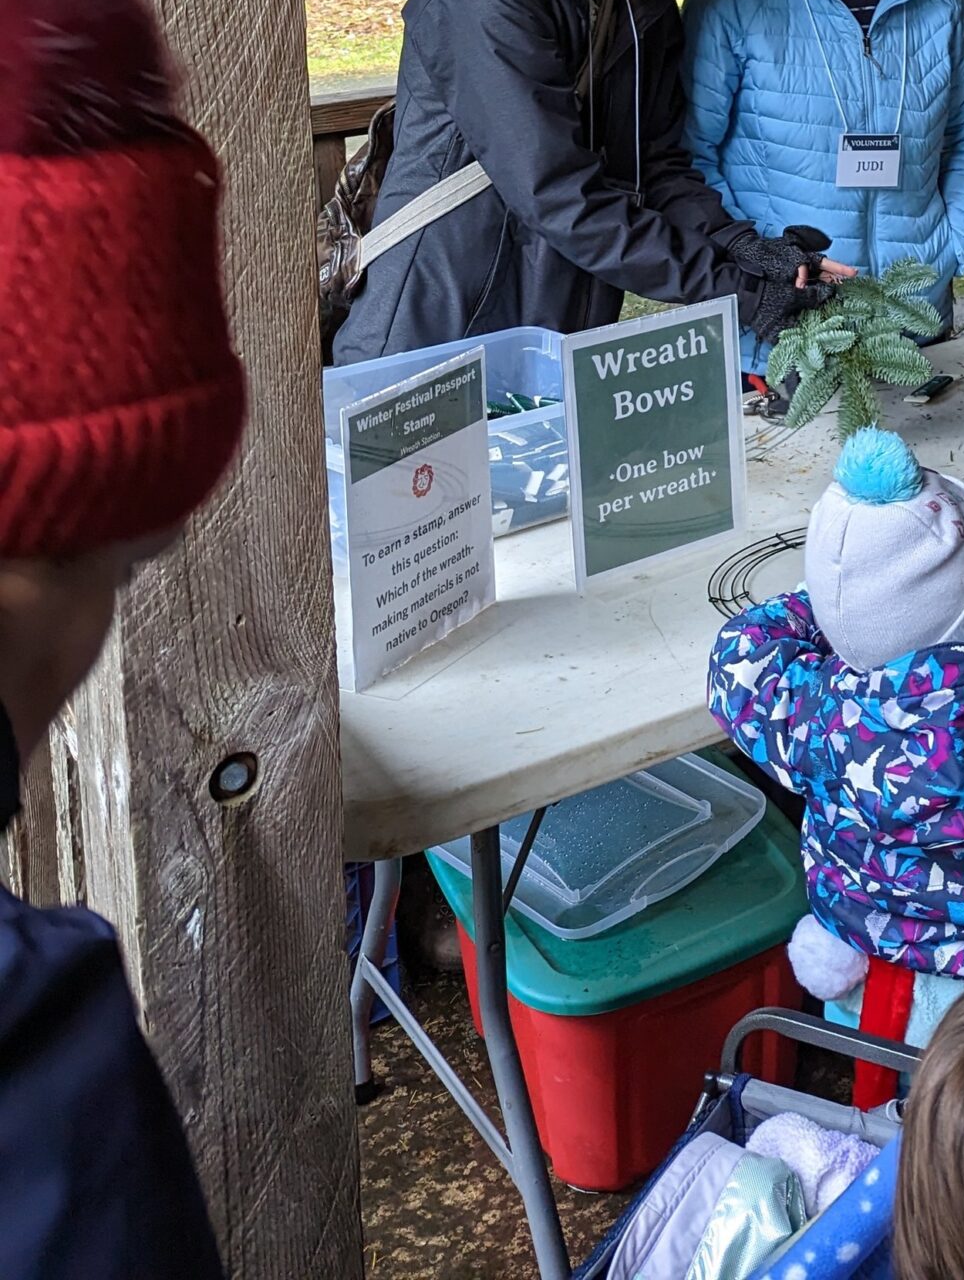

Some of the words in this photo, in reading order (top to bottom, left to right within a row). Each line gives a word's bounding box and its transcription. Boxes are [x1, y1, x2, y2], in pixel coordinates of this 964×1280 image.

[856, 161, 884, 173] JUDI
[591, 328, 708, 380] Wreath
[356, 408, 394, 433] Winter
[395, 387, 433, 416] Festival
[434, 368, 476, 397] Passport
[403, 412, 436, 435] Stamp
[613, 381, 694, 420] Bows
[400, 441, 421, 457] Wreath
[663, 445, 705, 469] bow
[362, 552, 376, 567] To
[378, 539, 402, 559] earn
[404, 534, 411, 545] a
[412, 515, 446, 540] stamp,
[448, 494, 481, 520] answer
[598, 494, 634, 523] per
[391, 557, 412, 576] this
[413, 530, 459, 565] question:
[372, 606, 409, 637] making
[410, 578, 455, 613] materials
[455, 573, 464, 586] is
[464, 561, 481, 580] not
[376, 581, 409, 609] Which
[410, 573, 420, 589] of
[421, 565, 438, 581] the
[439, 544, 475, 571] wreath-
[386, 626, 418, 652] native
[417, 617, 428, 631] to
[429, 590, 470, 624] Oregon?
